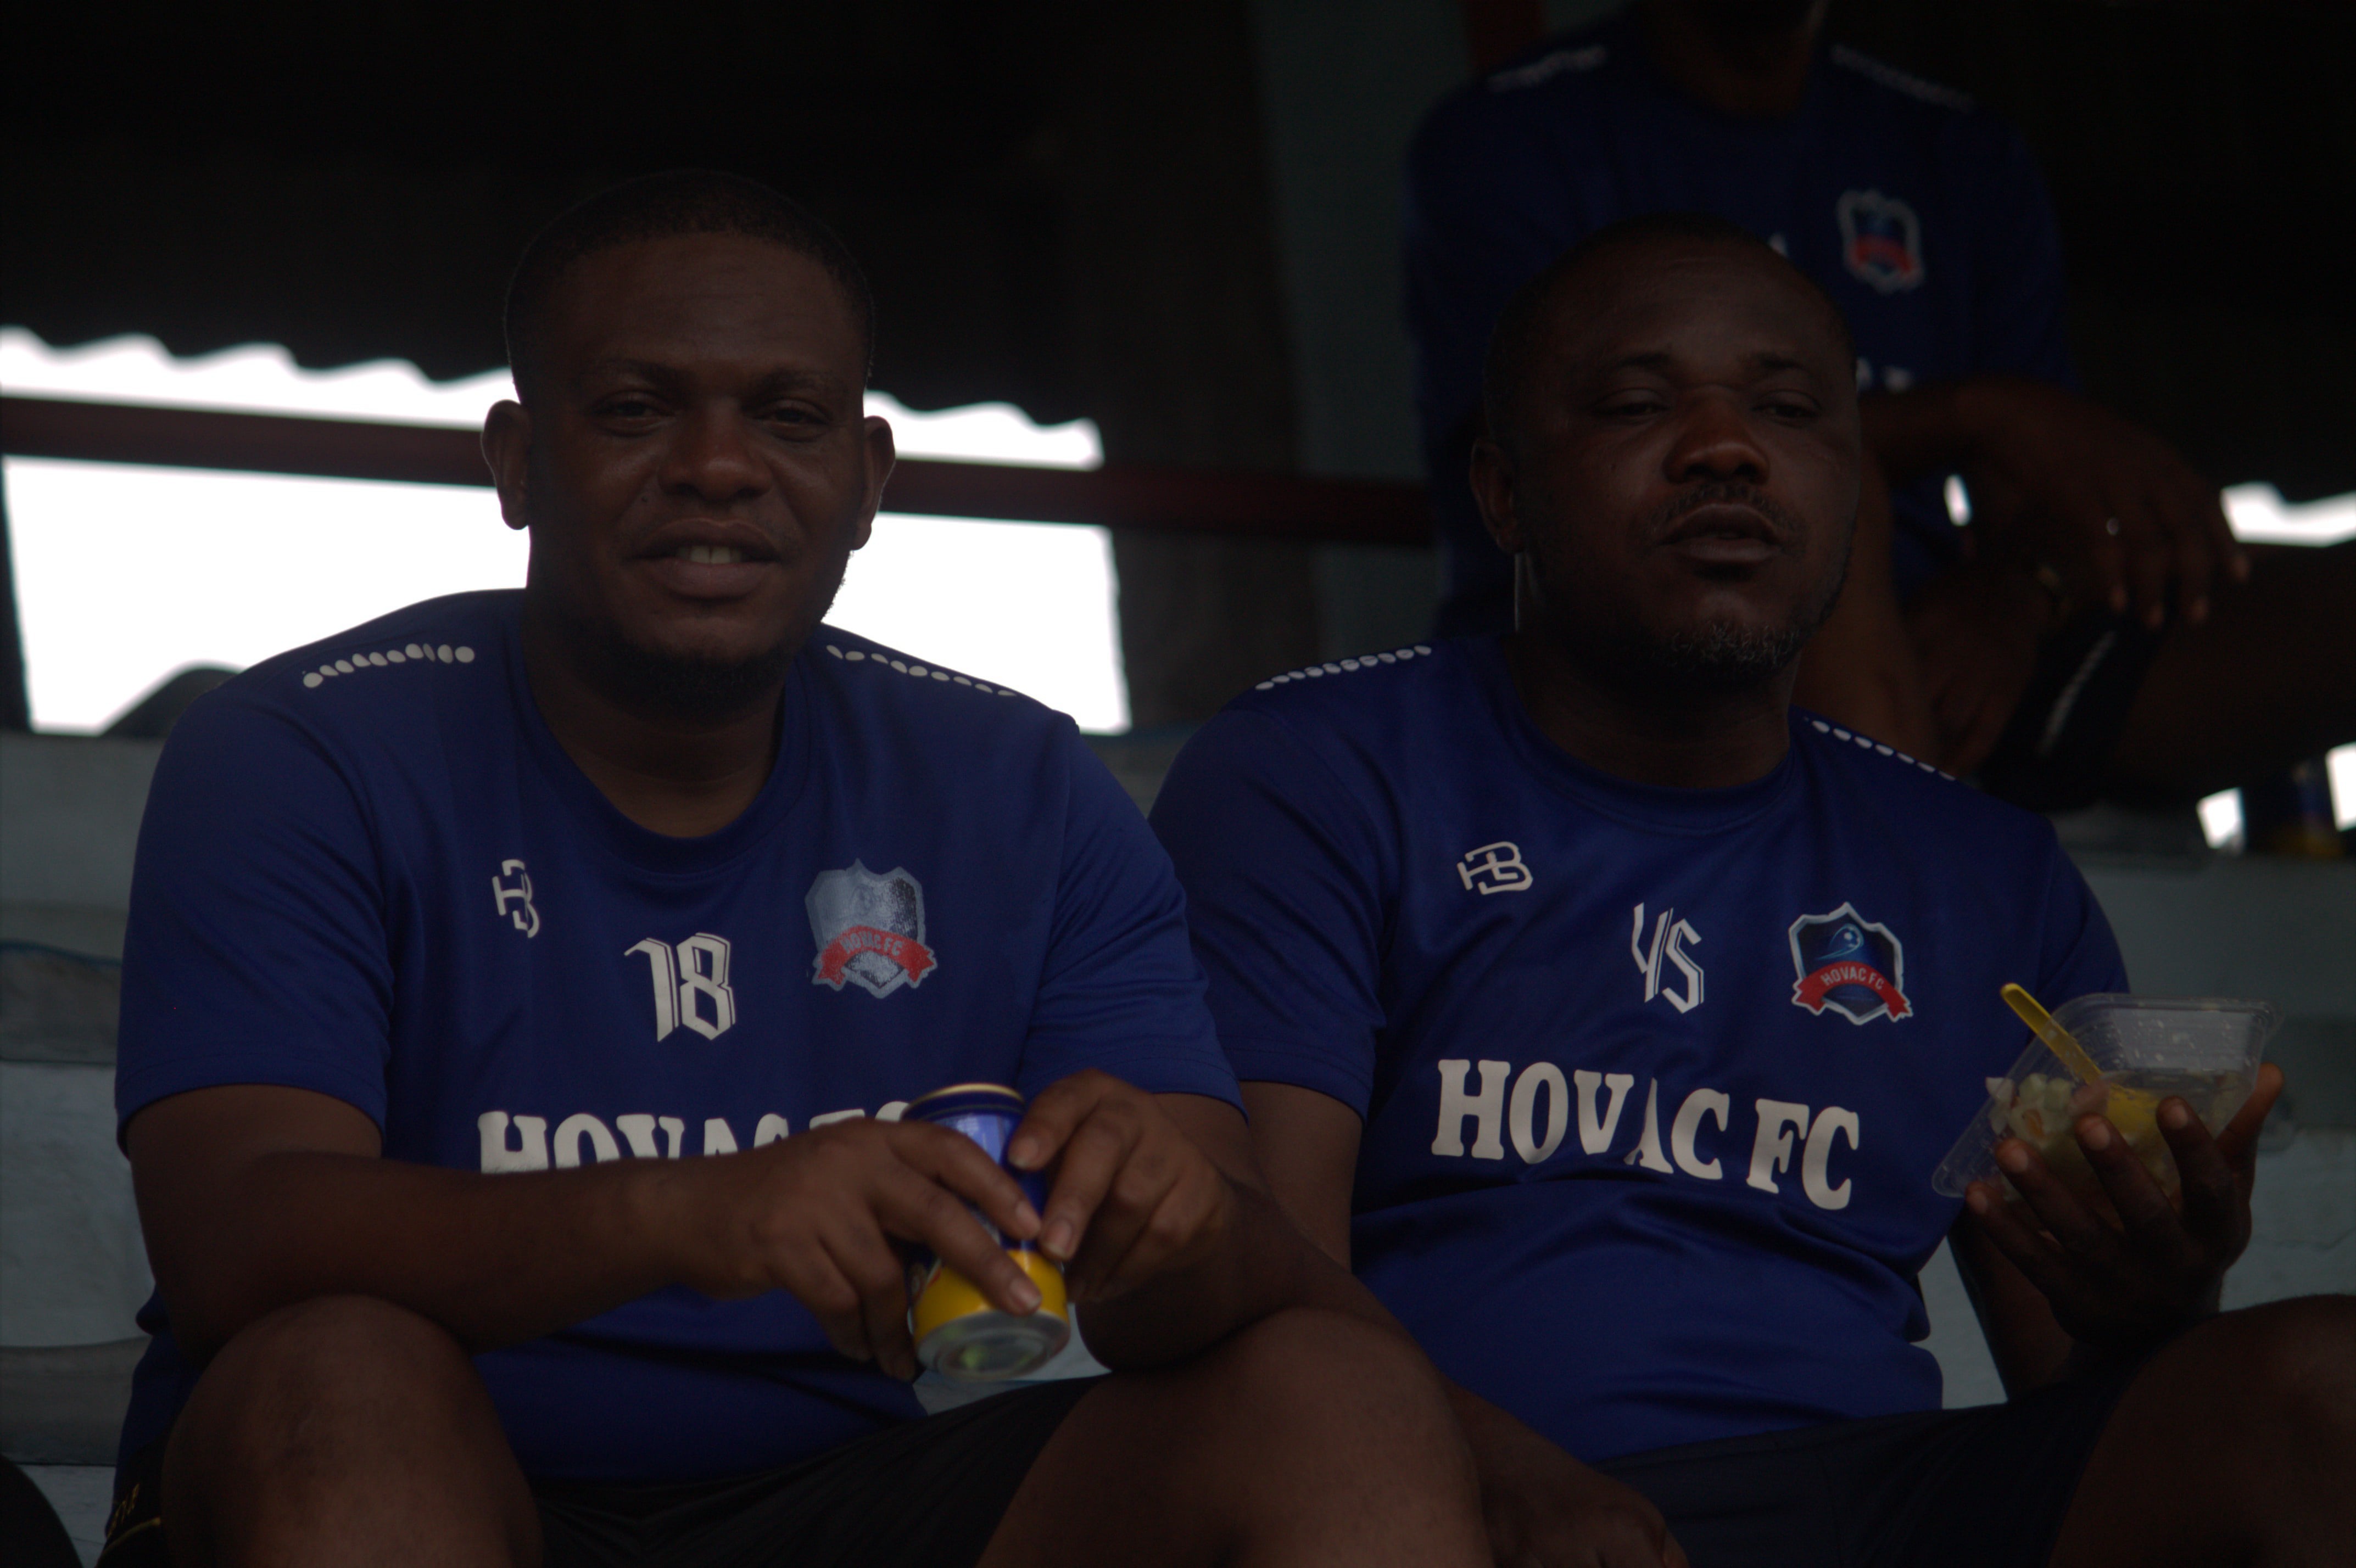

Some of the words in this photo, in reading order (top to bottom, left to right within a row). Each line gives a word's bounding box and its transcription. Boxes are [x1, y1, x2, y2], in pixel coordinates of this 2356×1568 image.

[884, 938, 903, 956] FC
[1820, 966, 1866, 986] HOVAC
[1868, 972, 1884, 990] FC
[624, 932, 736, 1042] 18
[477, 1111, 790, 1174] HOV
[1431, 1059, 1730, 1180] HOVAC
[1746, 1098, 1860, 1211] FC
